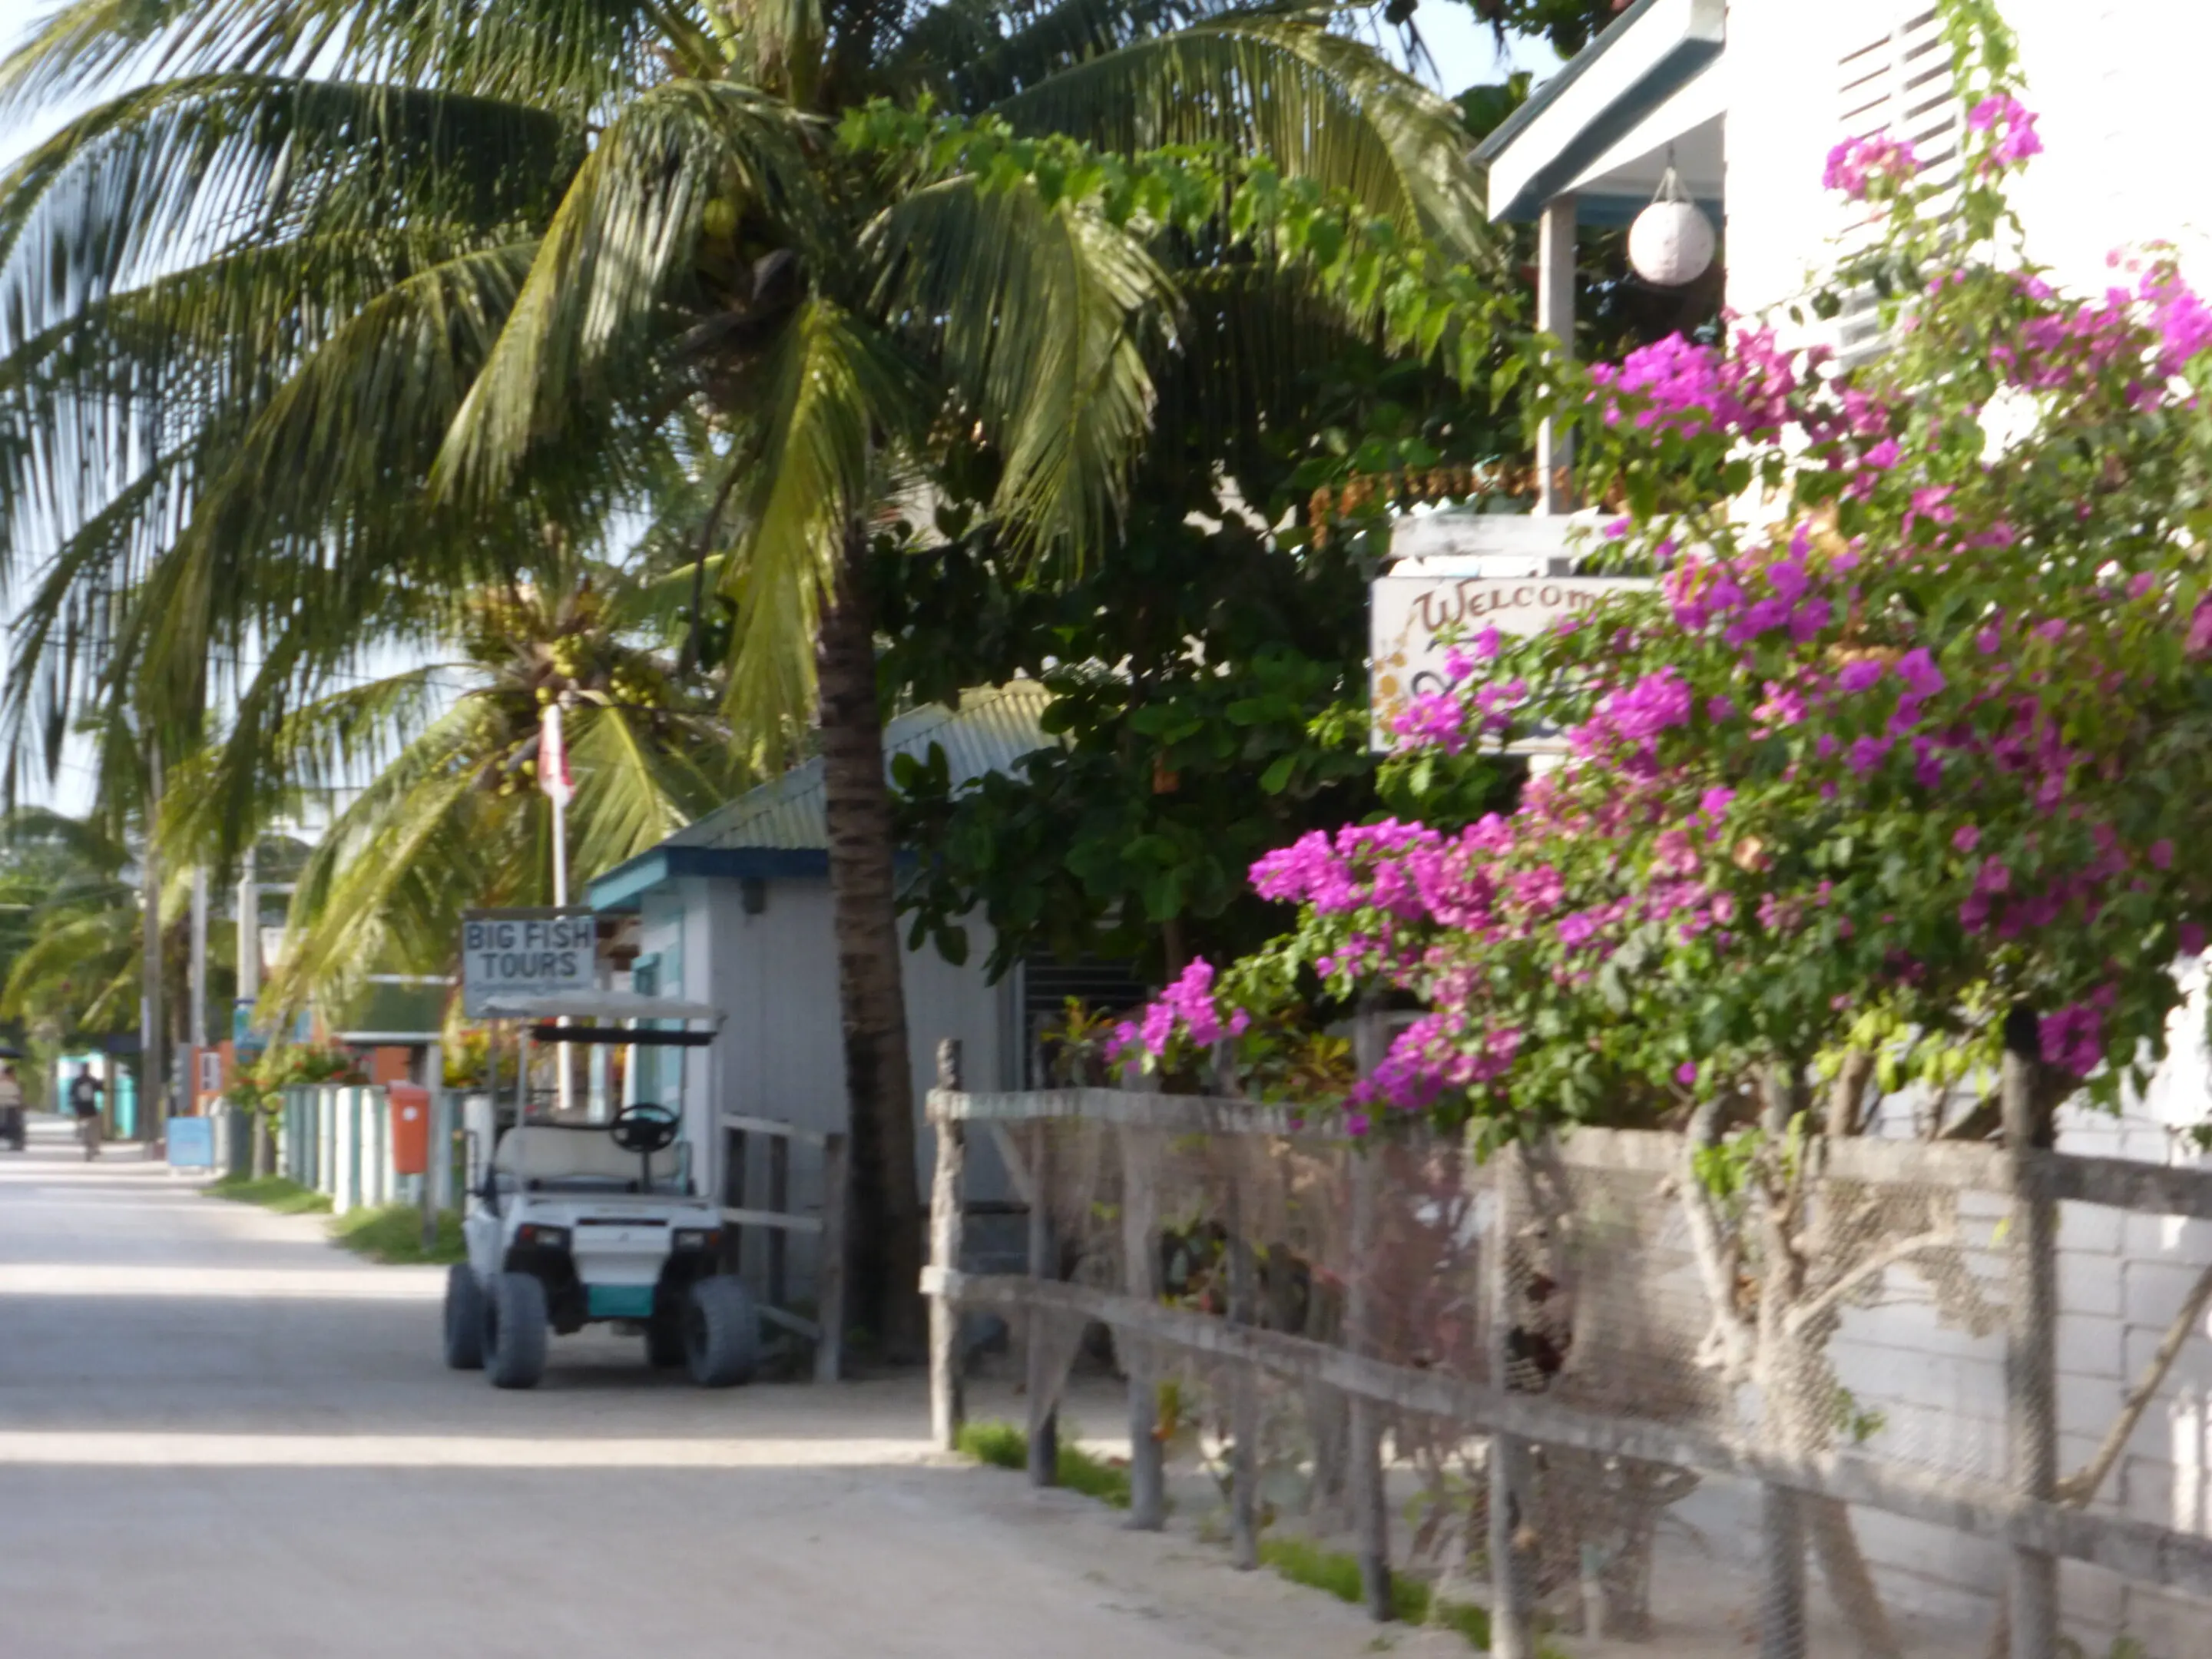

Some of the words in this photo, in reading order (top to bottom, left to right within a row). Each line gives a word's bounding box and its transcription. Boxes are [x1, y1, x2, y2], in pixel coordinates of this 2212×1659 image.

[1413, 577, 1608, 632] WELCOM
[467, 923, 515, 950] BIG
[525, 922, 590, 949] FISH
[481, 951, 578, 979] TOURS
